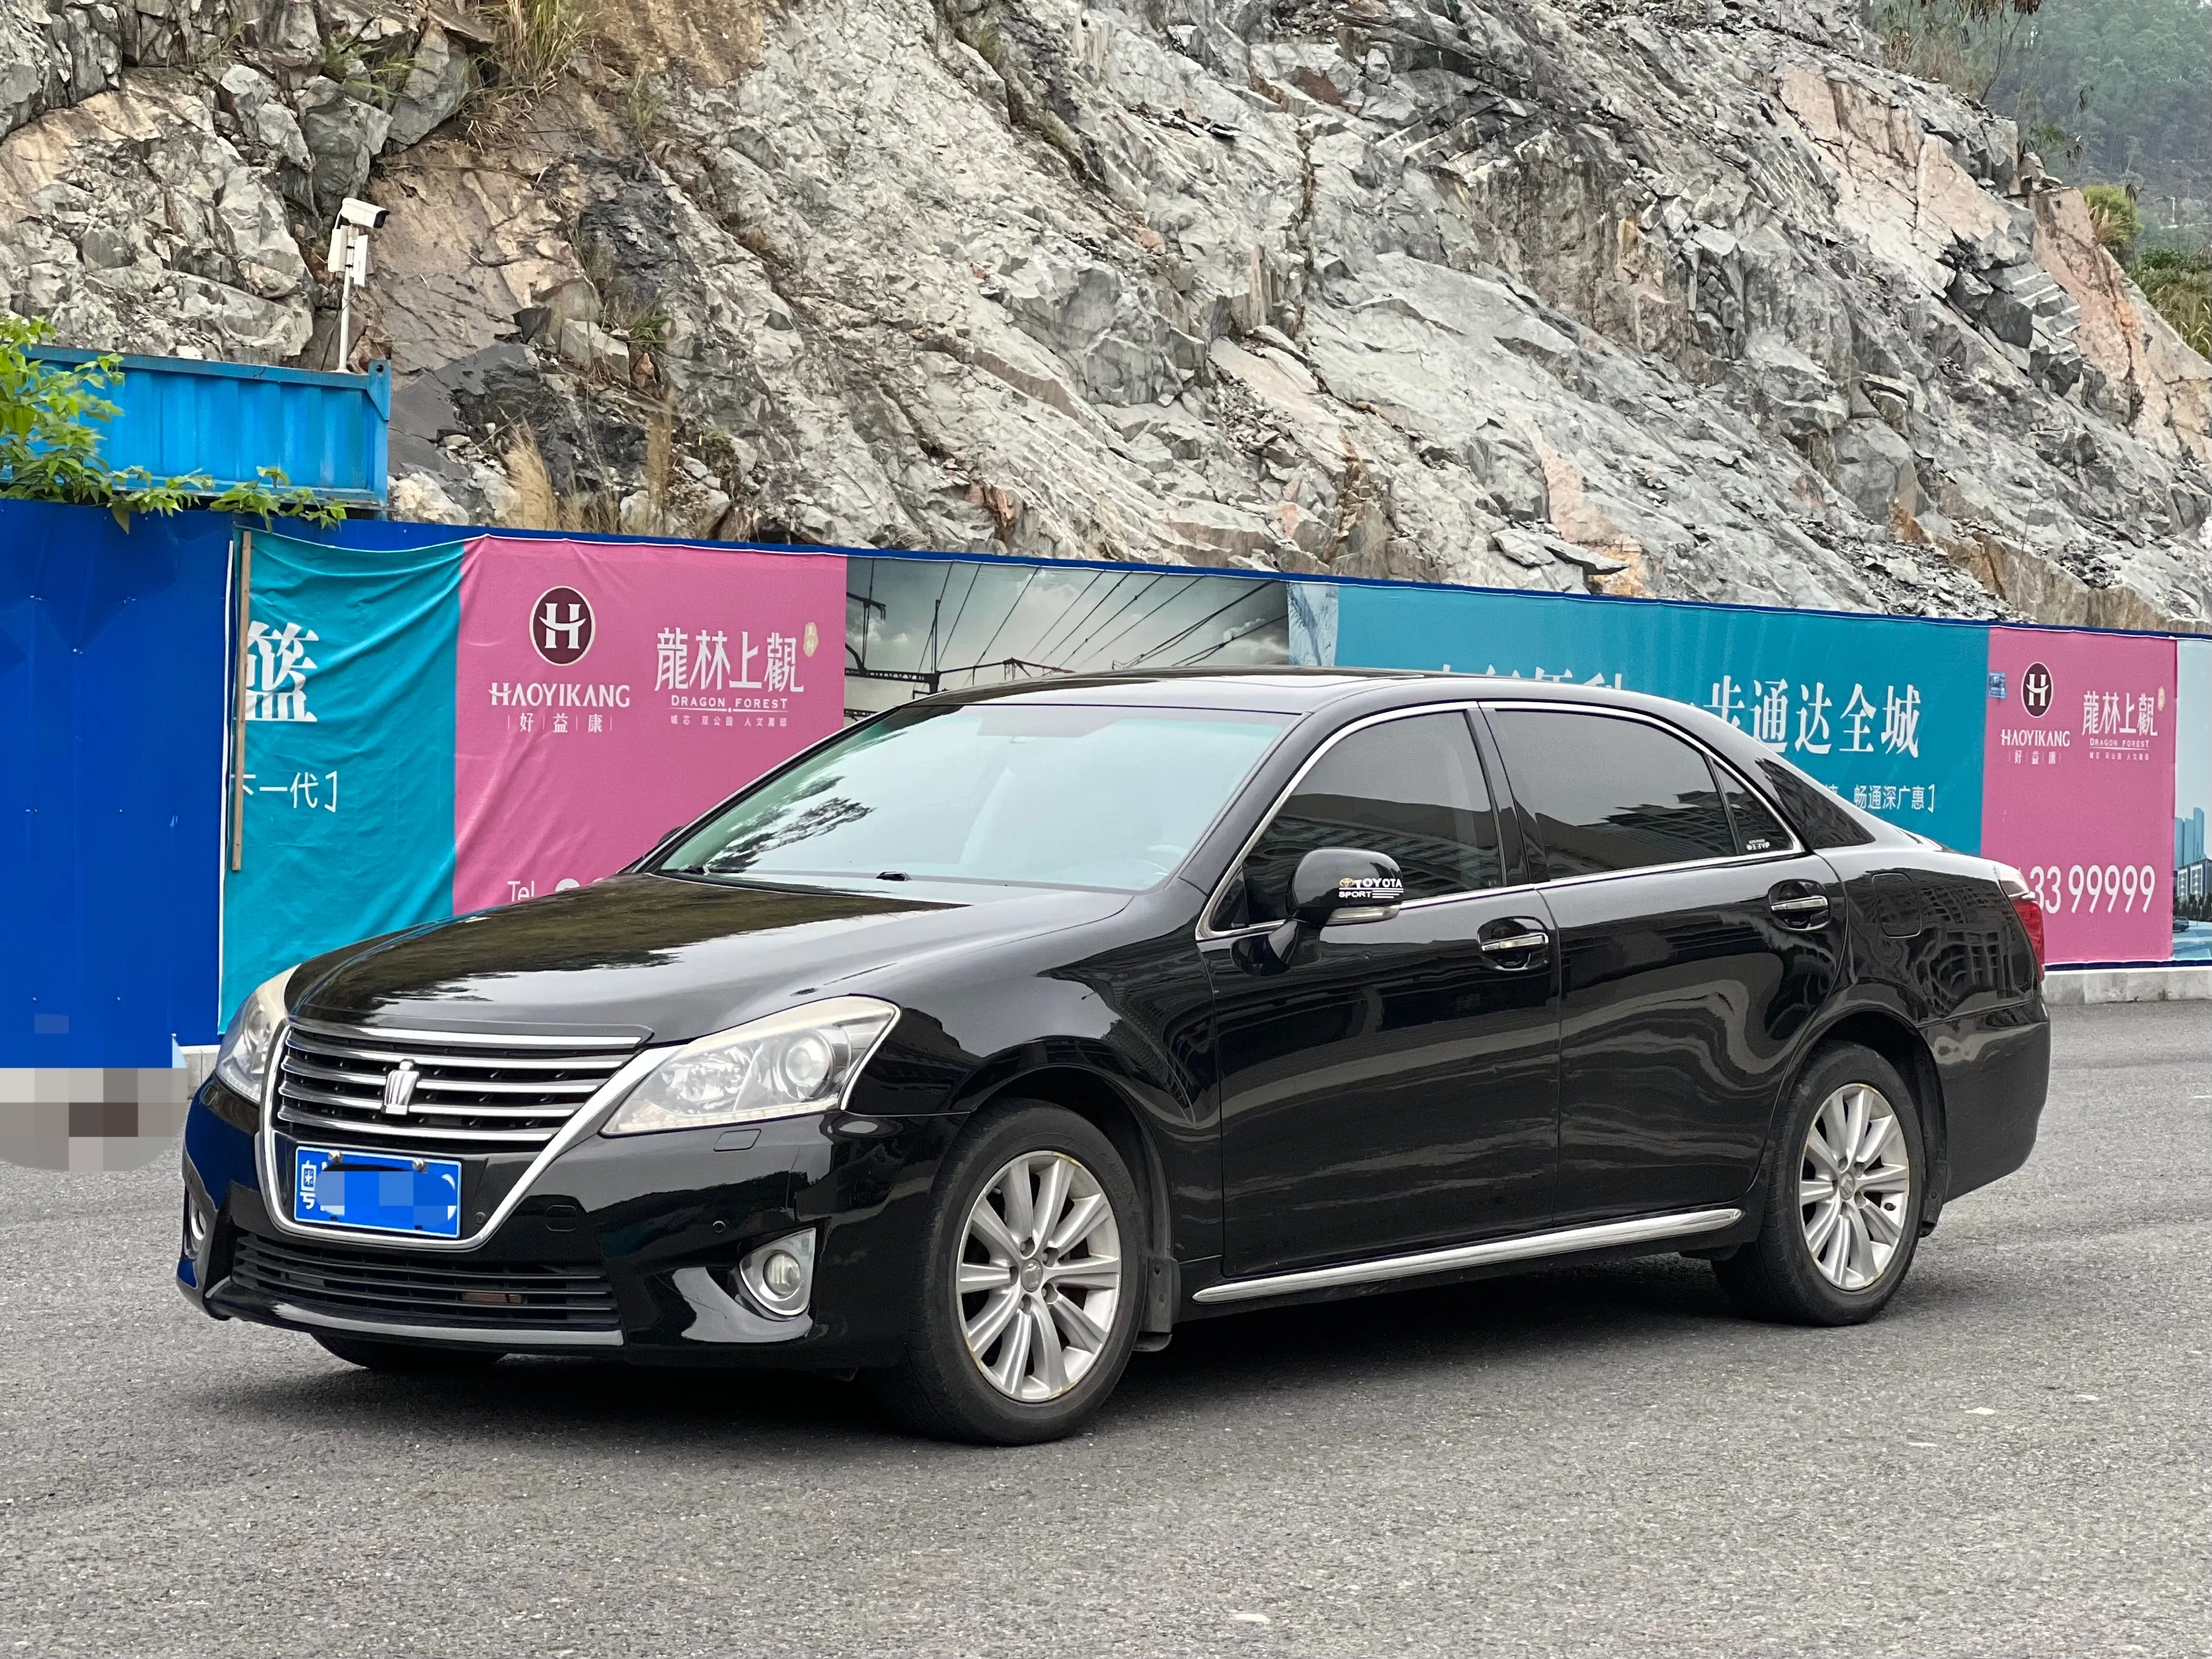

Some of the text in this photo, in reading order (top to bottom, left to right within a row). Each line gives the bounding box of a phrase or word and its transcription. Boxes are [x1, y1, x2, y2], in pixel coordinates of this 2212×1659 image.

[654, 626, 805, 693] 龍林上觀
[488, 682, 630, 708] HAOYIKANG
[671, 695, 788, 709] DRAGON FOREST
[1690, 675, 1921, 758] 步通达全城
[2000, 729, 2070, 747] HAOYIKANG
[2089, 738, 2149, 748] DRAGON FOREST
[1353, 877, 1403, 889] TOYOTA
[2068, 865, 2156, 914] 99999
[1338, 890, 1373, 899] SPORT
